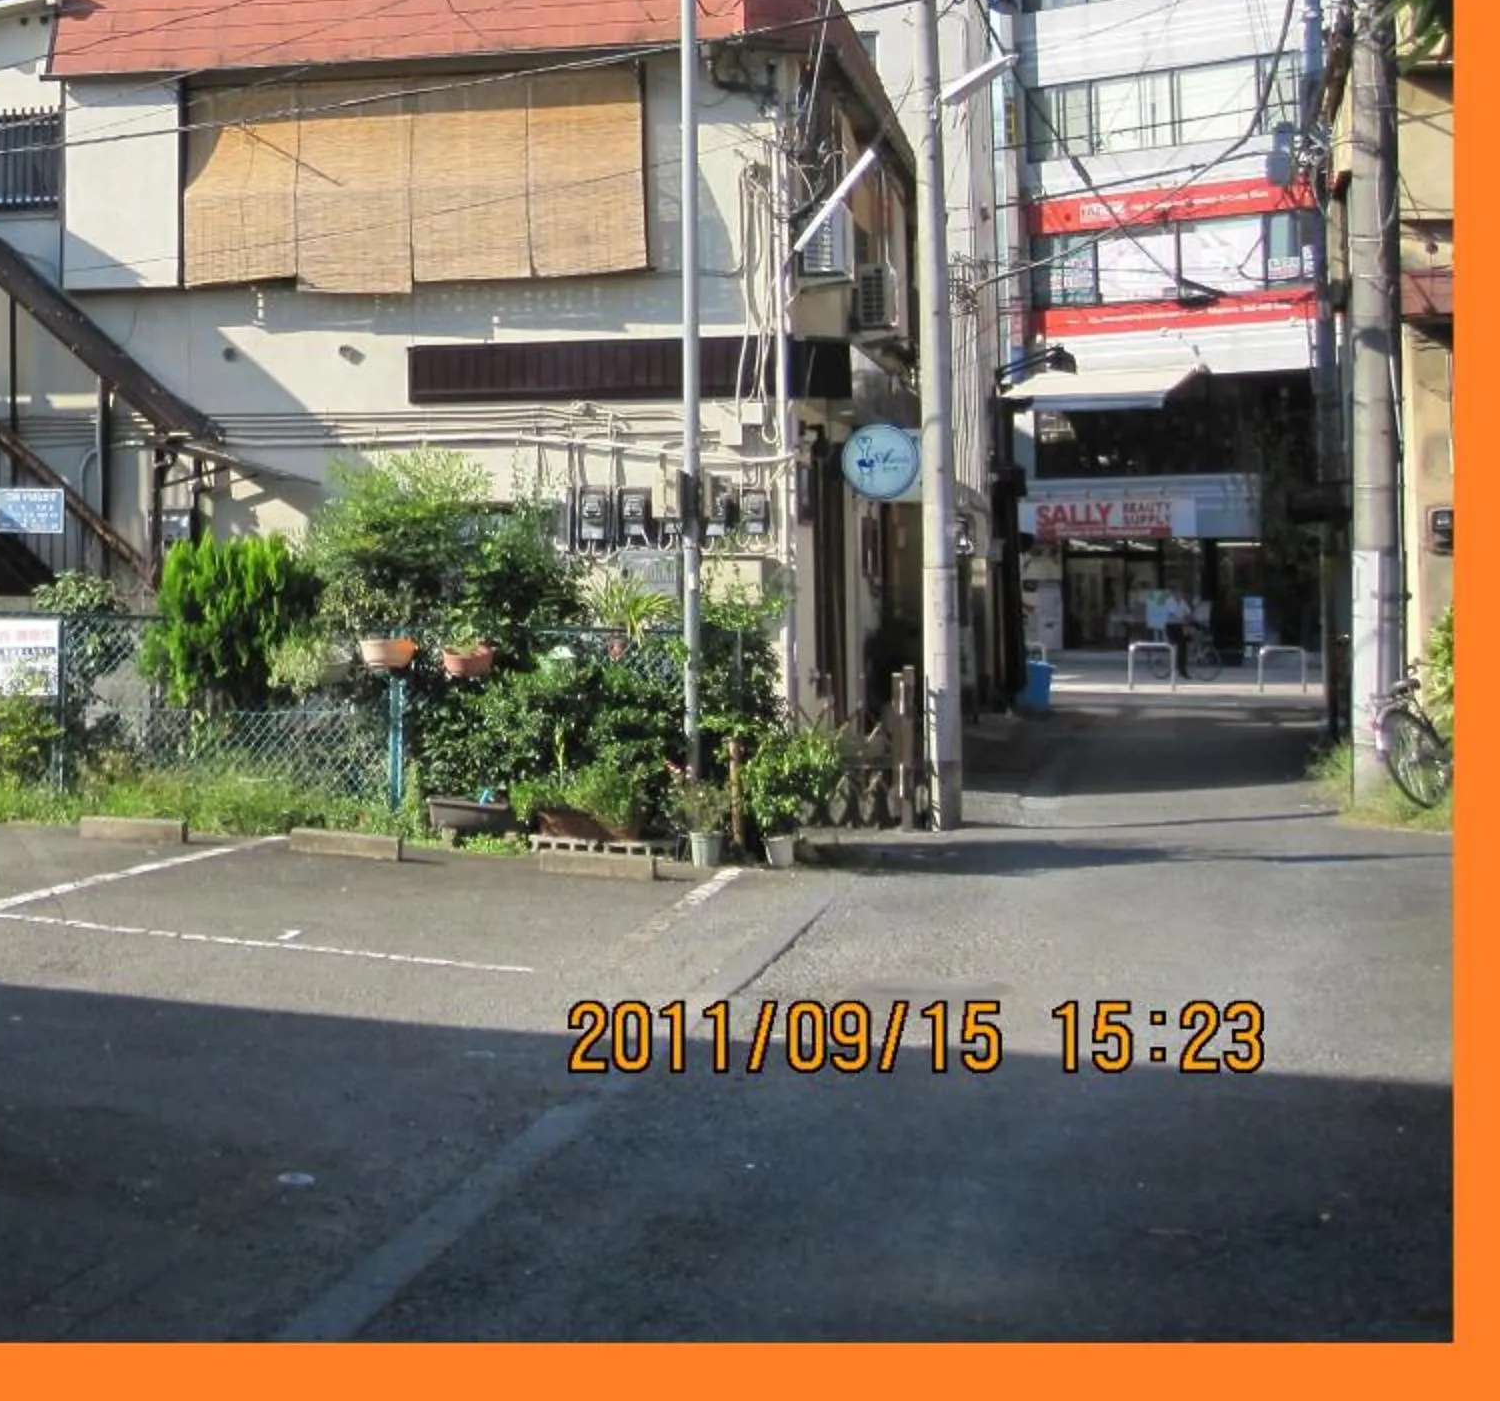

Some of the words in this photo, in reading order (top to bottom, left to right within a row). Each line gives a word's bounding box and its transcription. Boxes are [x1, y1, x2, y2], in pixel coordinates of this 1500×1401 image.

[1036, 502, 1113, 526] SALLY
[1122, 501, 1172, 514] BEAUTY
[1122, 513, 1172, 526] SUPPLY
